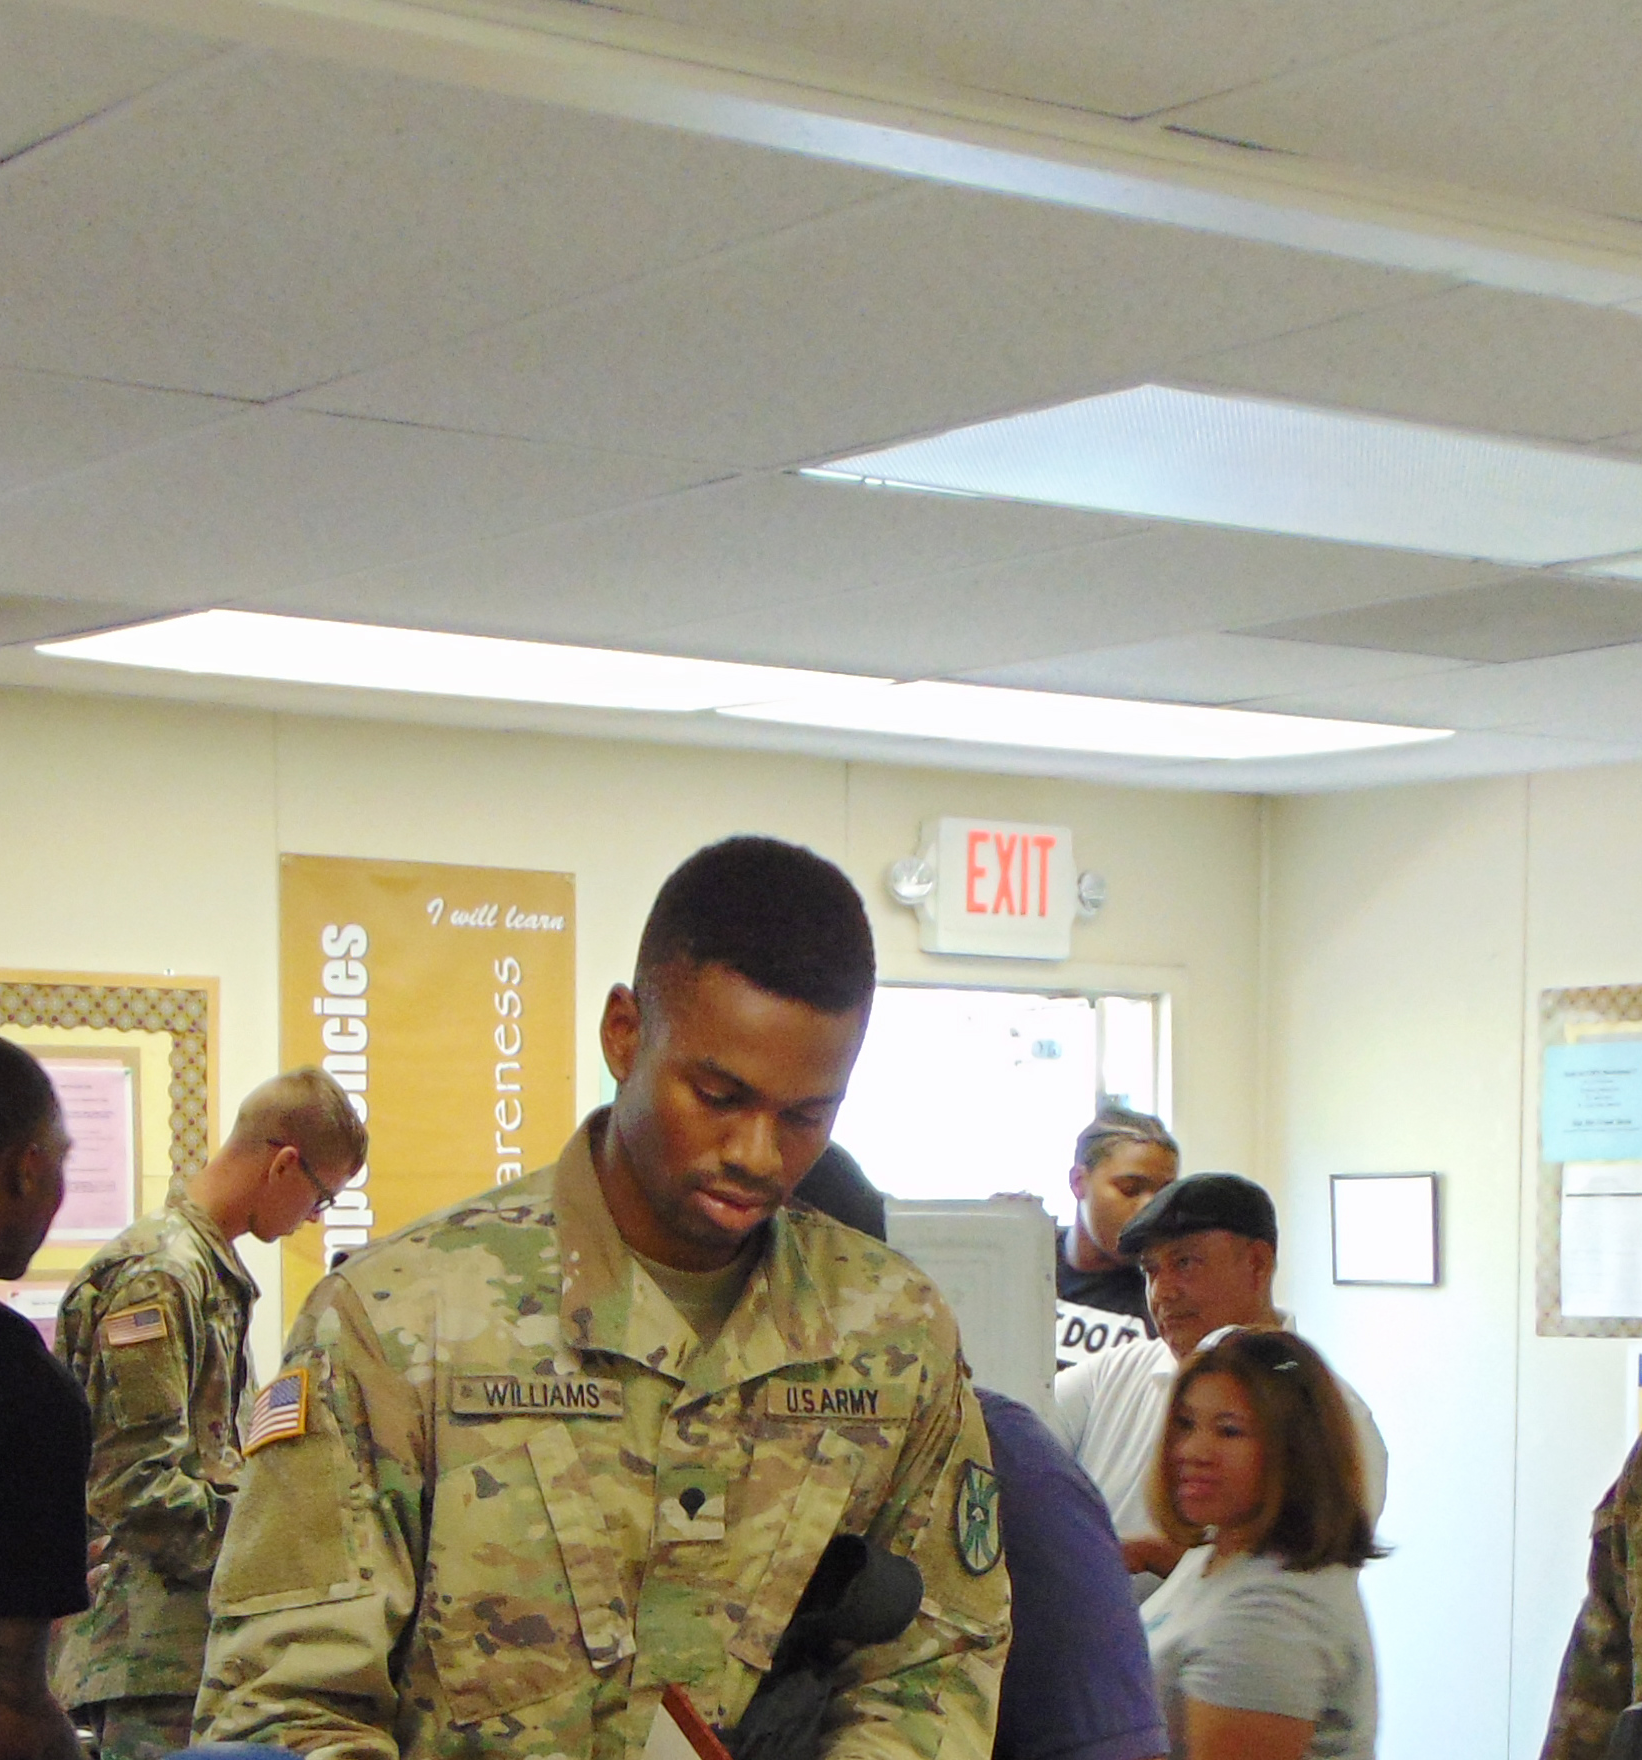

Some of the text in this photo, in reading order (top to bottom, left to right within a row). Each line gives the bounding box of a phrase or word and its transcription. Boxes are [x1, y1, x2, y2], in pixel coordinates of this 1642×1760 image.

[966, 829, 1057, 918] EXIT
[426, 898, 566, 931] I will learn
[494, 956, 524, 1187] areness
[1062, 1316, 1109, 1353] DO
[483, 1382, 600, 1409] WILLIAMS
